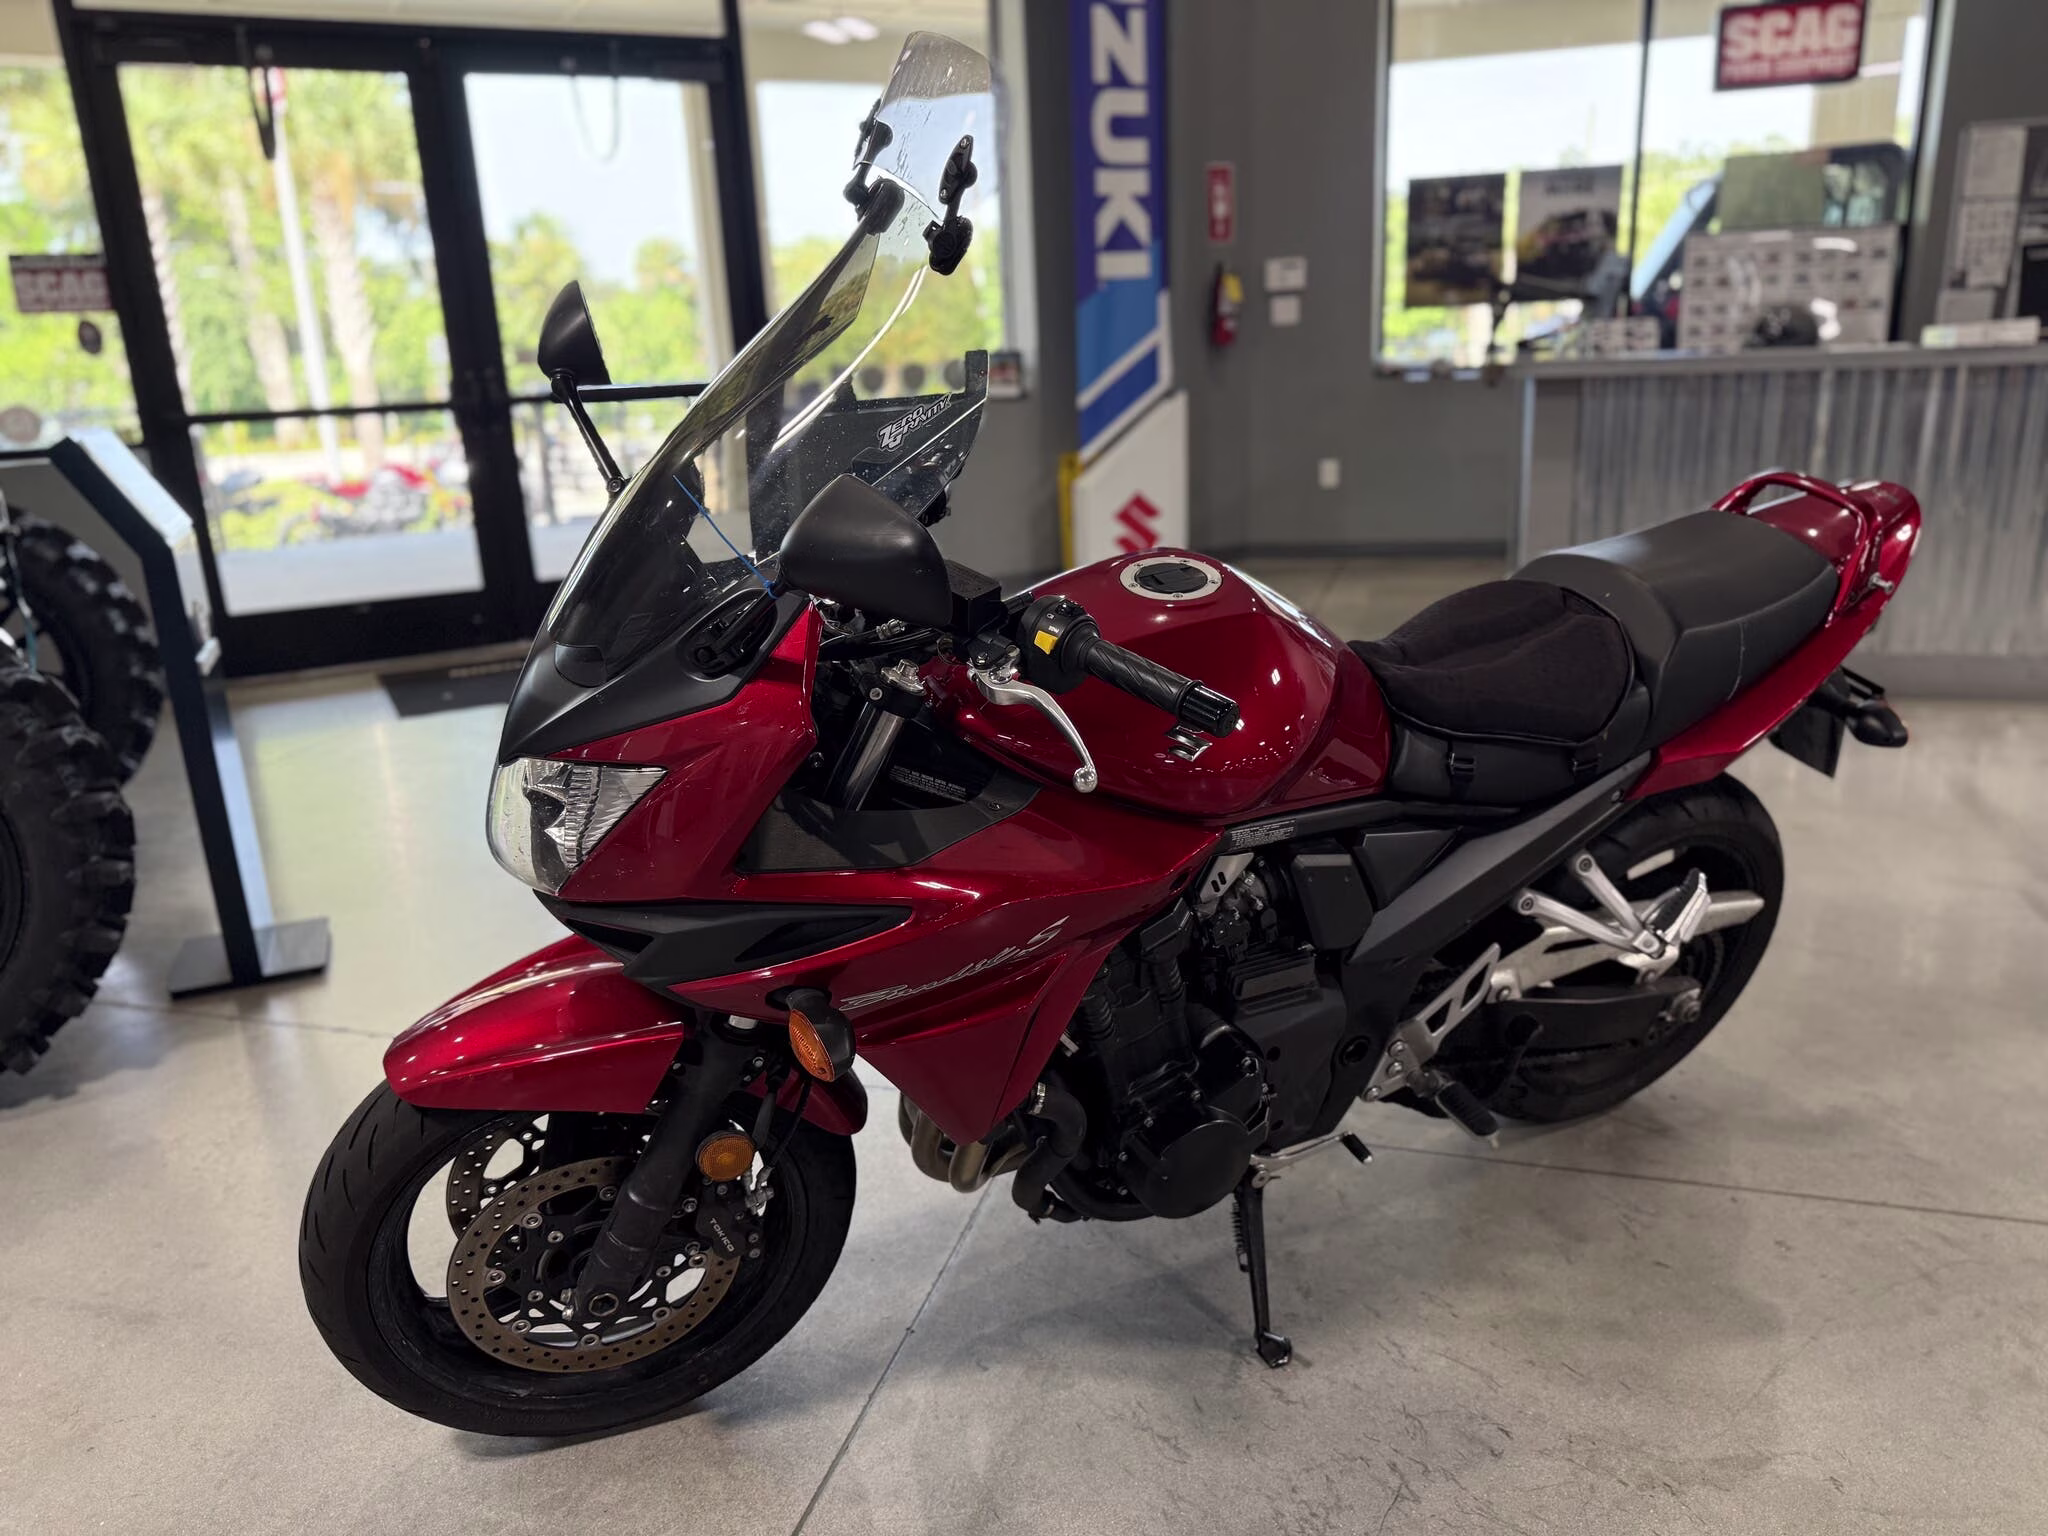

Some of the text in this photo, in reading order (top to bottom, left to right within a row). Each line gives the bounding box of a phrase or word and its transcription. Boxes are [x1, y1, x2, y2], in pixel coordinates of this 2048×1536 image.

[1725, 3, 1858, 60] SCAG
[1090, 0, 1152, 280] ZUKI
[879, 406, 924, 448] ZERO
[888, 393, 951, 449] GRAVITY
[710, 1217, 735, 1252] TOKICO
